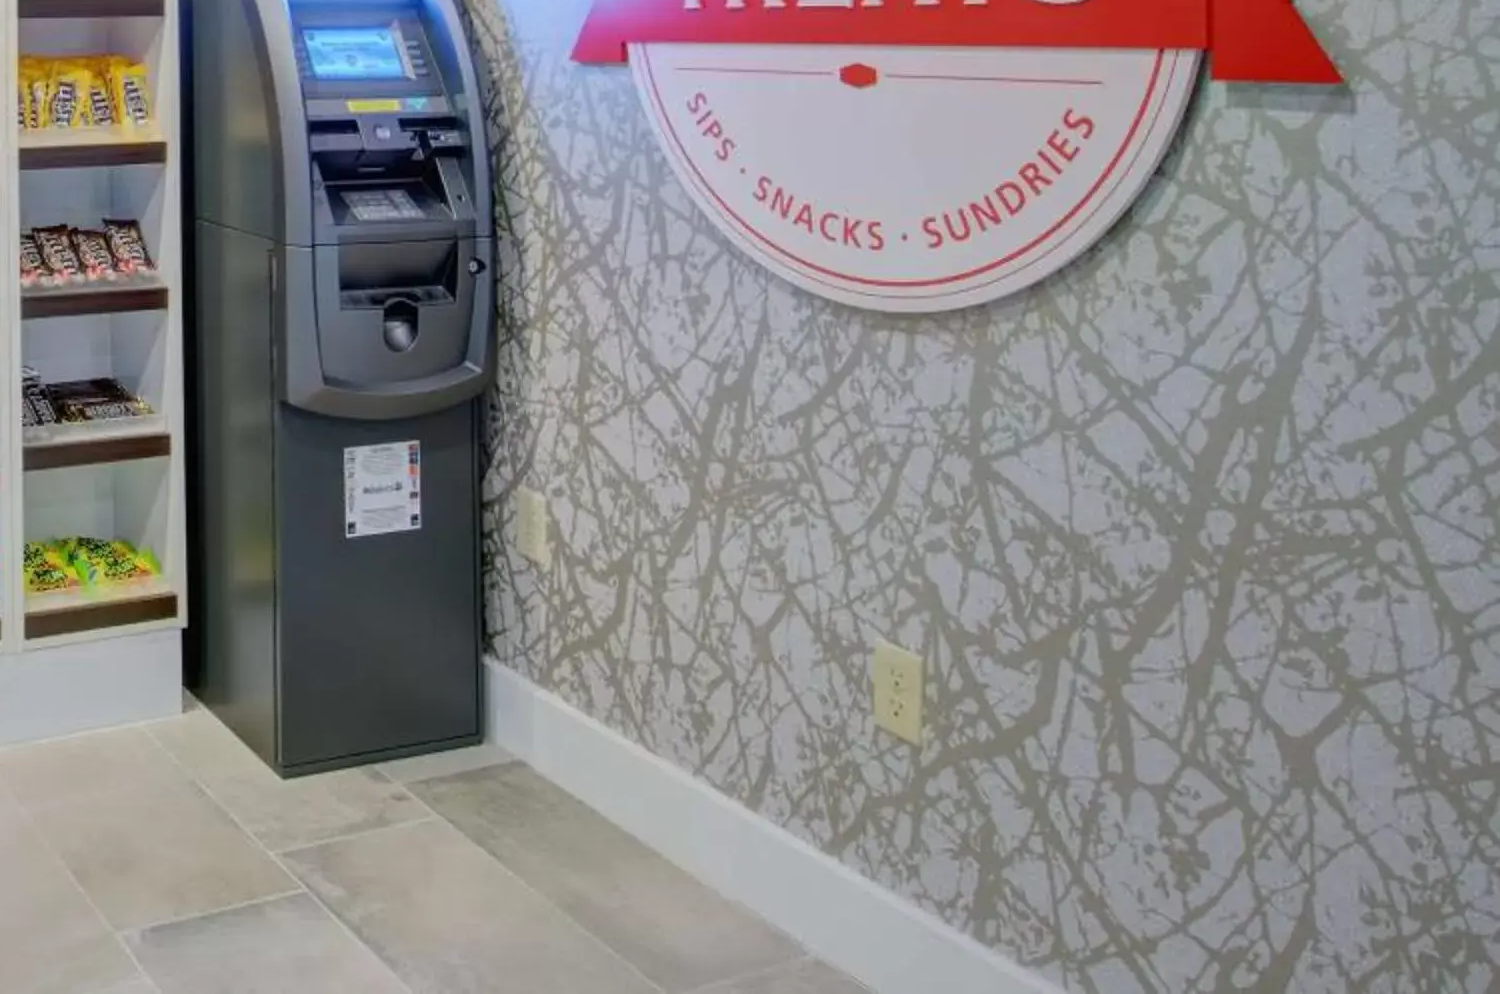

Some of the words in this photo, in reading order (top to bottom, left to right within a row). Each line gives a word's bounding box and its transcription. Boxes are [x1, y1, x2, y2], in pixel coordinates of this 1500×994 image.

[686, 92, 735, 161] SIPS
[752, 176, 885, 251] SNACKS
[922, 107, 1095, 248] SUNDRIES
